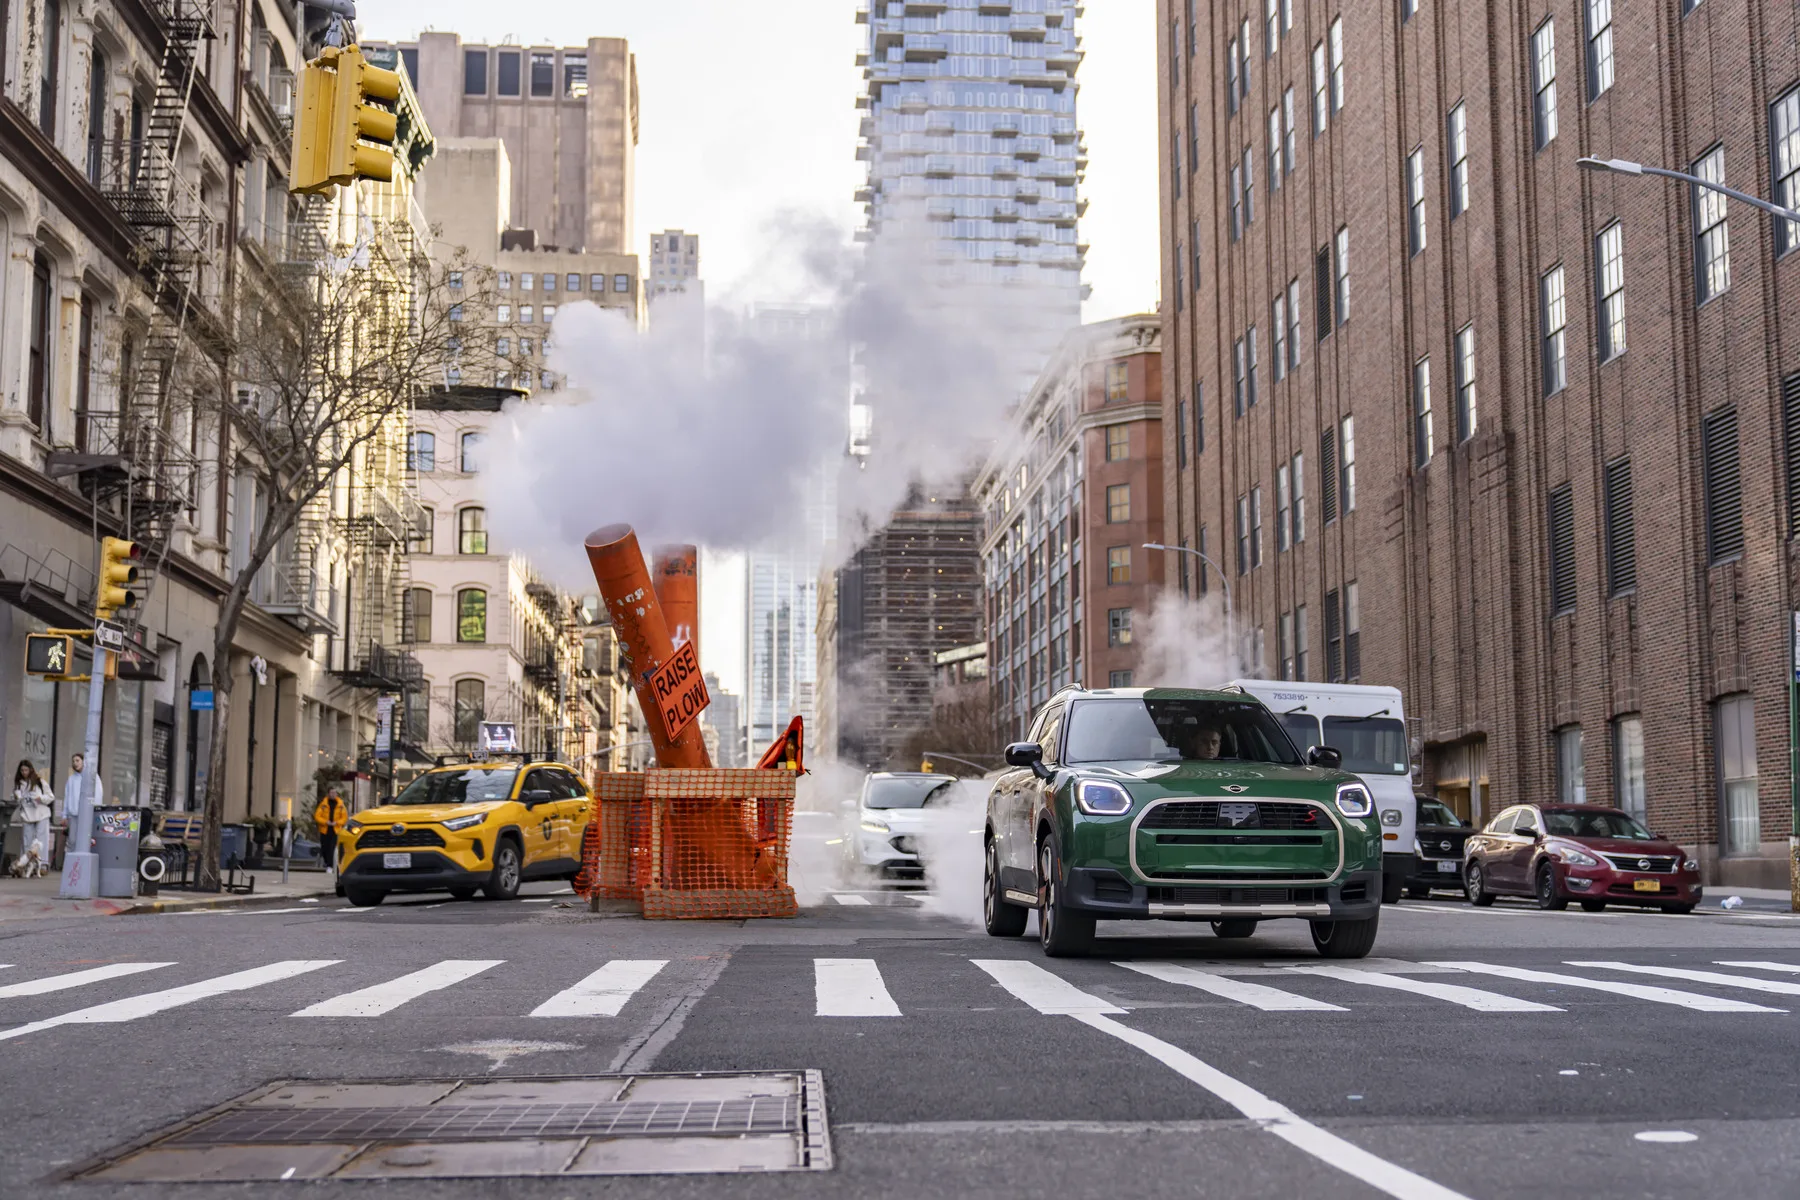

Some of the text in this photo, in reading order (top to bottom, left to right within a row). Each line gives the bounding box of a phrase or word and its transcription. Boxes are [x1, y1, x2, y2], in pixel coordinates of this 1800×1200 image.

[99, 628, 121, 643] ONE WAY
[655, 648, 696, 701] RAISE
[666, 680, 704, 732] PLOW
[25, 730, 46, 755] RKS
[1304, 809, 1317, 823] S
